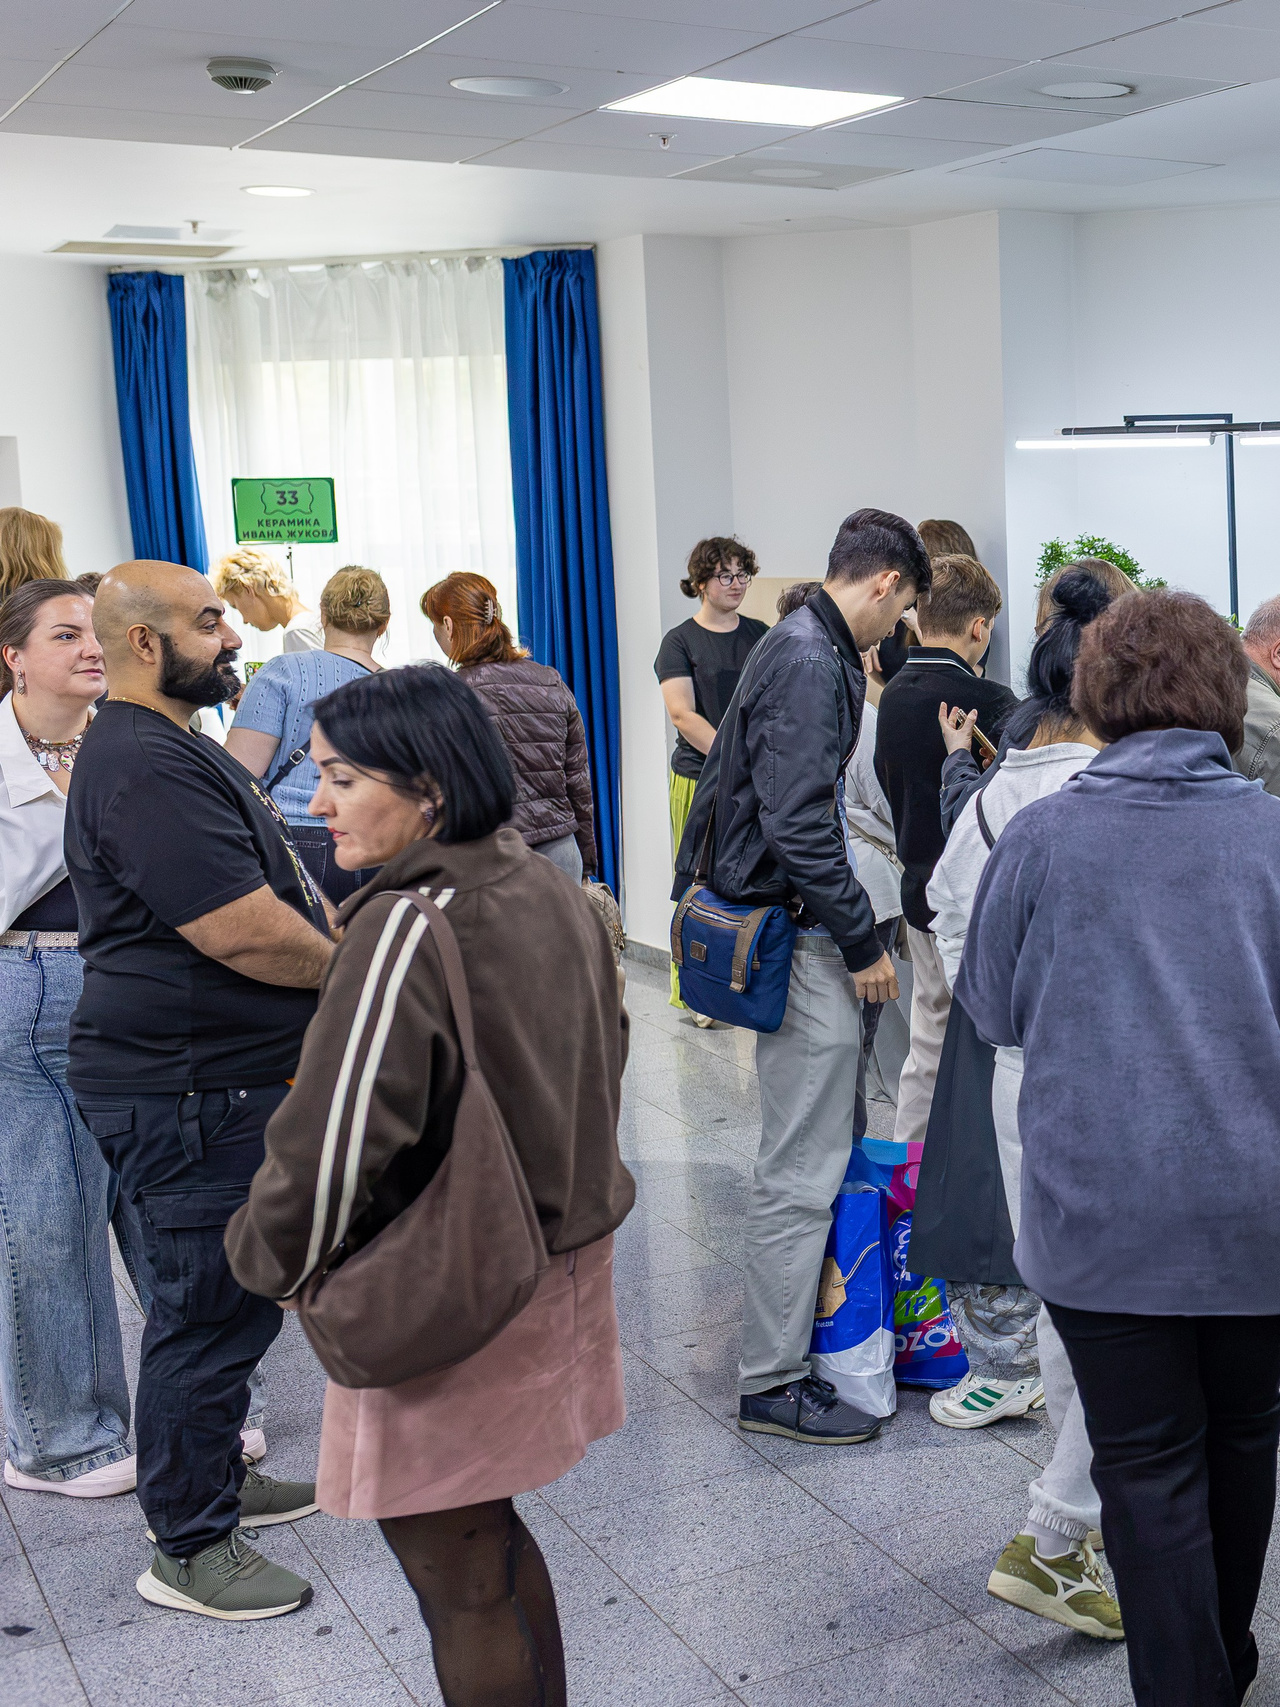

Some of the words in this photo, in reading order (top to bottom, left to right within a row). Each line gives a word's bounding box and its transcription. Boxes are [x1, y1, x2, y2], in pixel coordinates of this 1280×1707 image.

[275, 490, 299, 505] 33
[257, 518, 320, 527] КЕРАМИКА
[242, 530, 283, 539] ИВАНА
